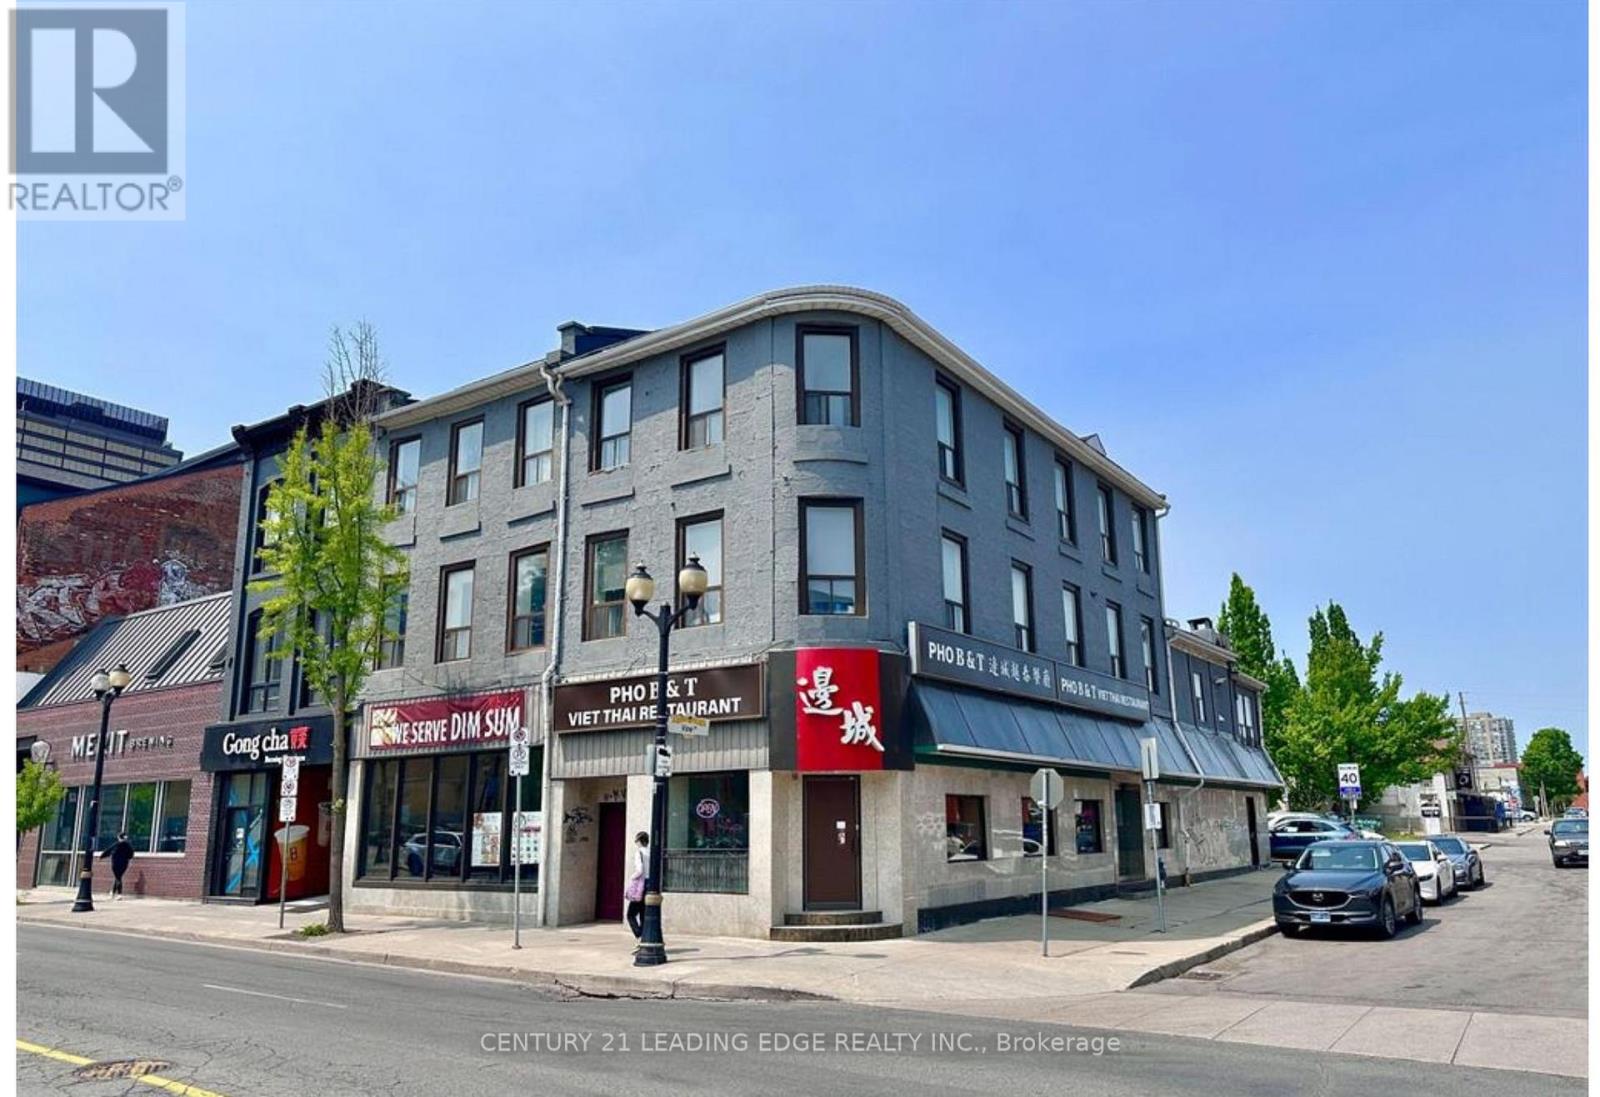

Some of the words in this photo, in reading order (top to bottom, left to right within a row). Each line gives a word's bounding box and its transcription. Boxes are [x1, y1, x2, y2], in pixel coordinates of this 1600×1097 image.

[928, 641, 954, 664] PHO
[610, 685, 646, 704] PHO
[666, 679, 680, 698] &
[684, 677, 698, 696] T
[1061, 677, 1078, 695] PHO
[568, 712, 600, 726] VIET
[603, 708, 636, 723] THAI
[639, 697, 742, 719] RETAURANT
[392, 722, 409, 745] WE
[411, 719, 447, 743] SERVE
[450, 710, 481, 741] DIM
[484, 706, 521, 738] SUM
[71, 730, 128, 758] MEIT
[223, 732, 261, 760] Gong
[262, 727, 289, 752] cha
[1341, 772, 1357, 784] 40
